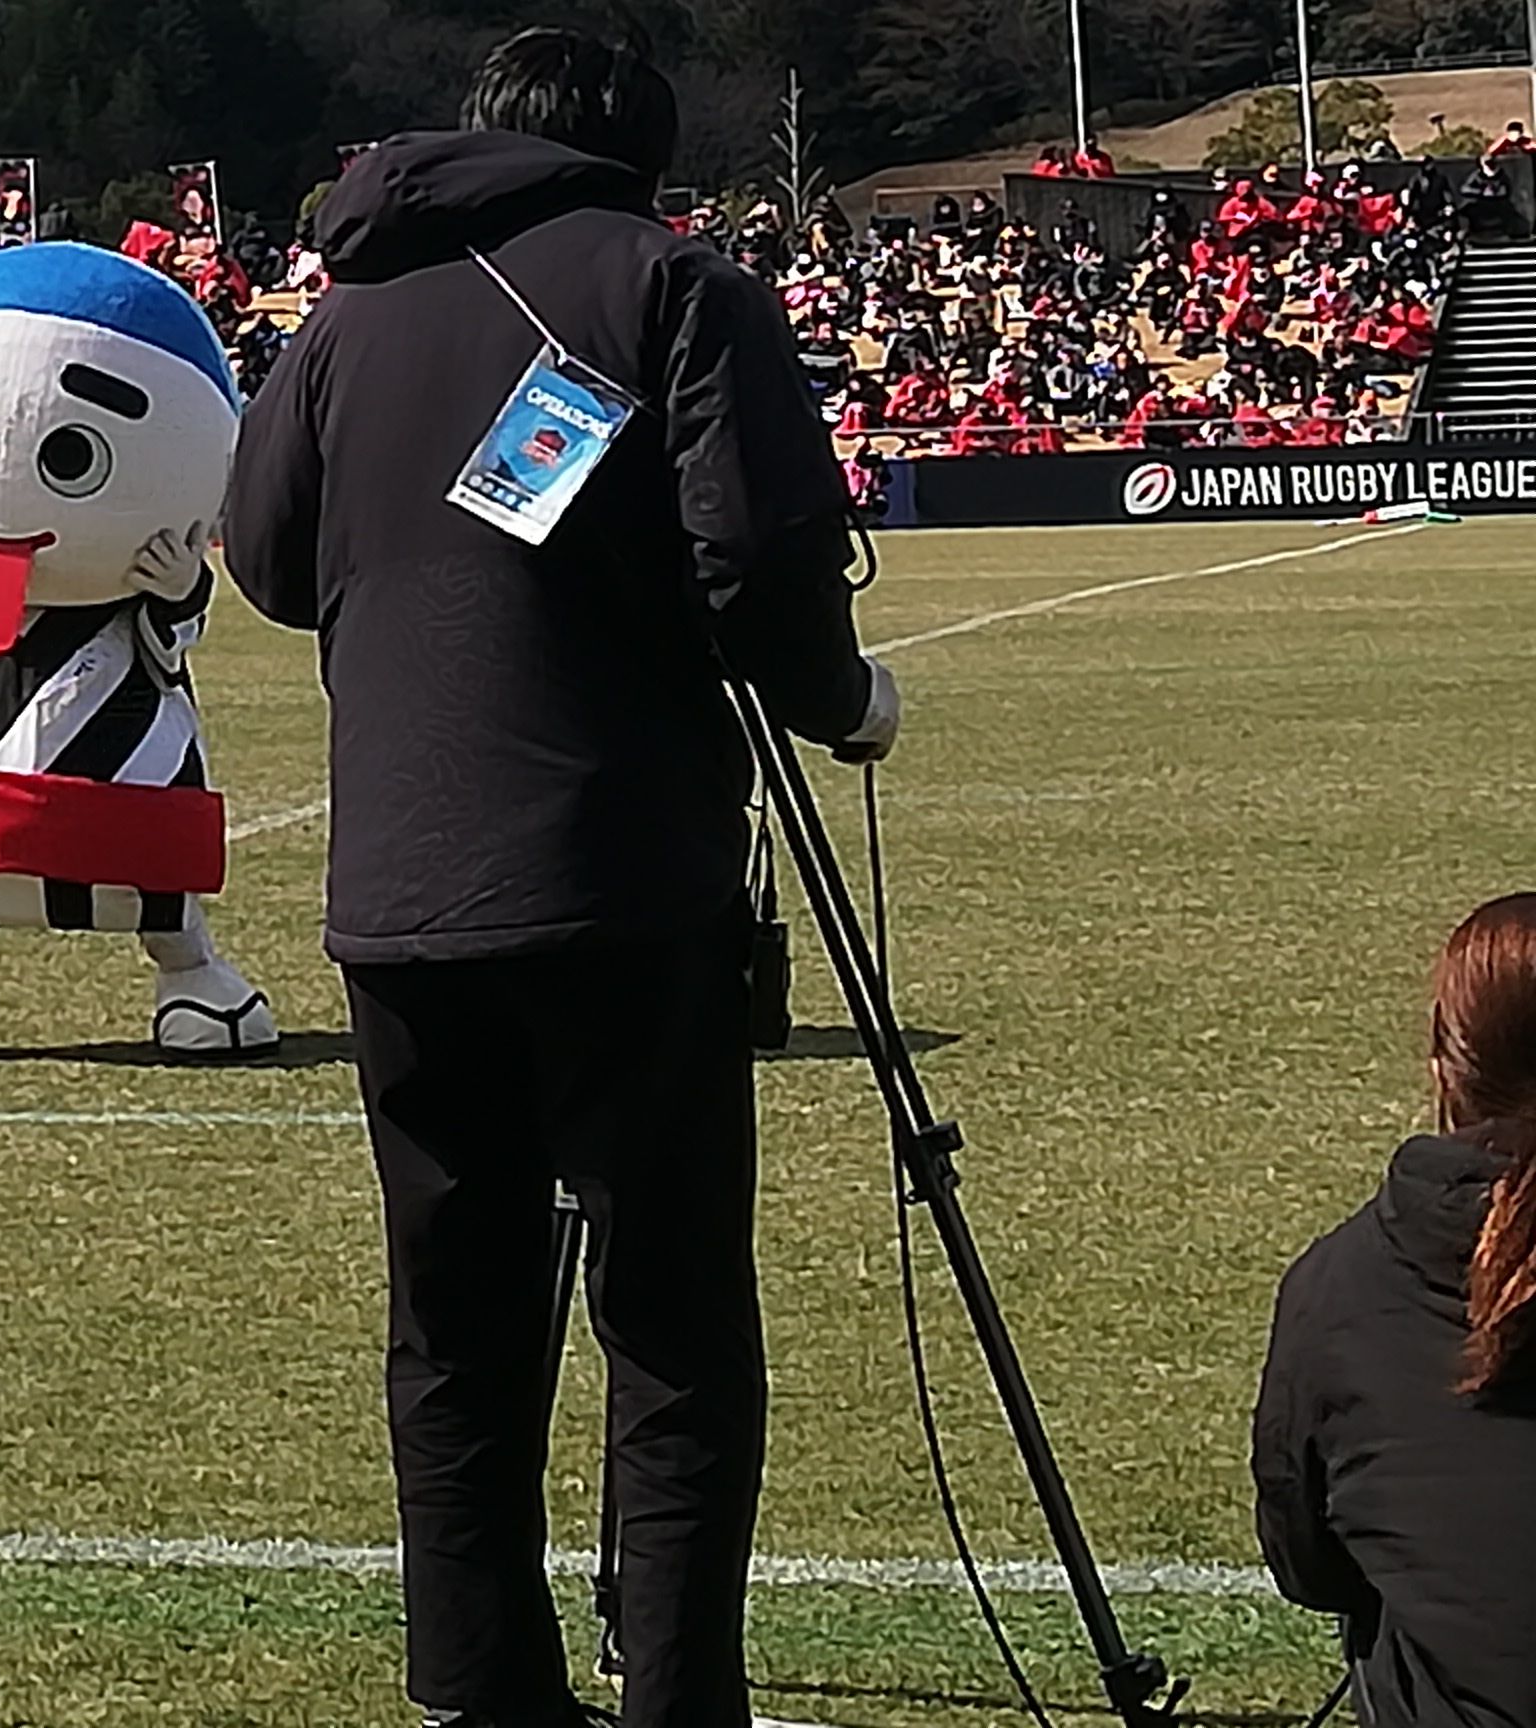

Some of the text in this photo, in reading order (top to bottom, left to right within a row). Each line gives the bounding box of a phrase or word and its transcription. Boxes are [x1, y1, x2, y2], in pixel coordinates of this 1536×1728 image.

[1181, 459, 1536, 507] JAPAN RUGBY LEAGUE
